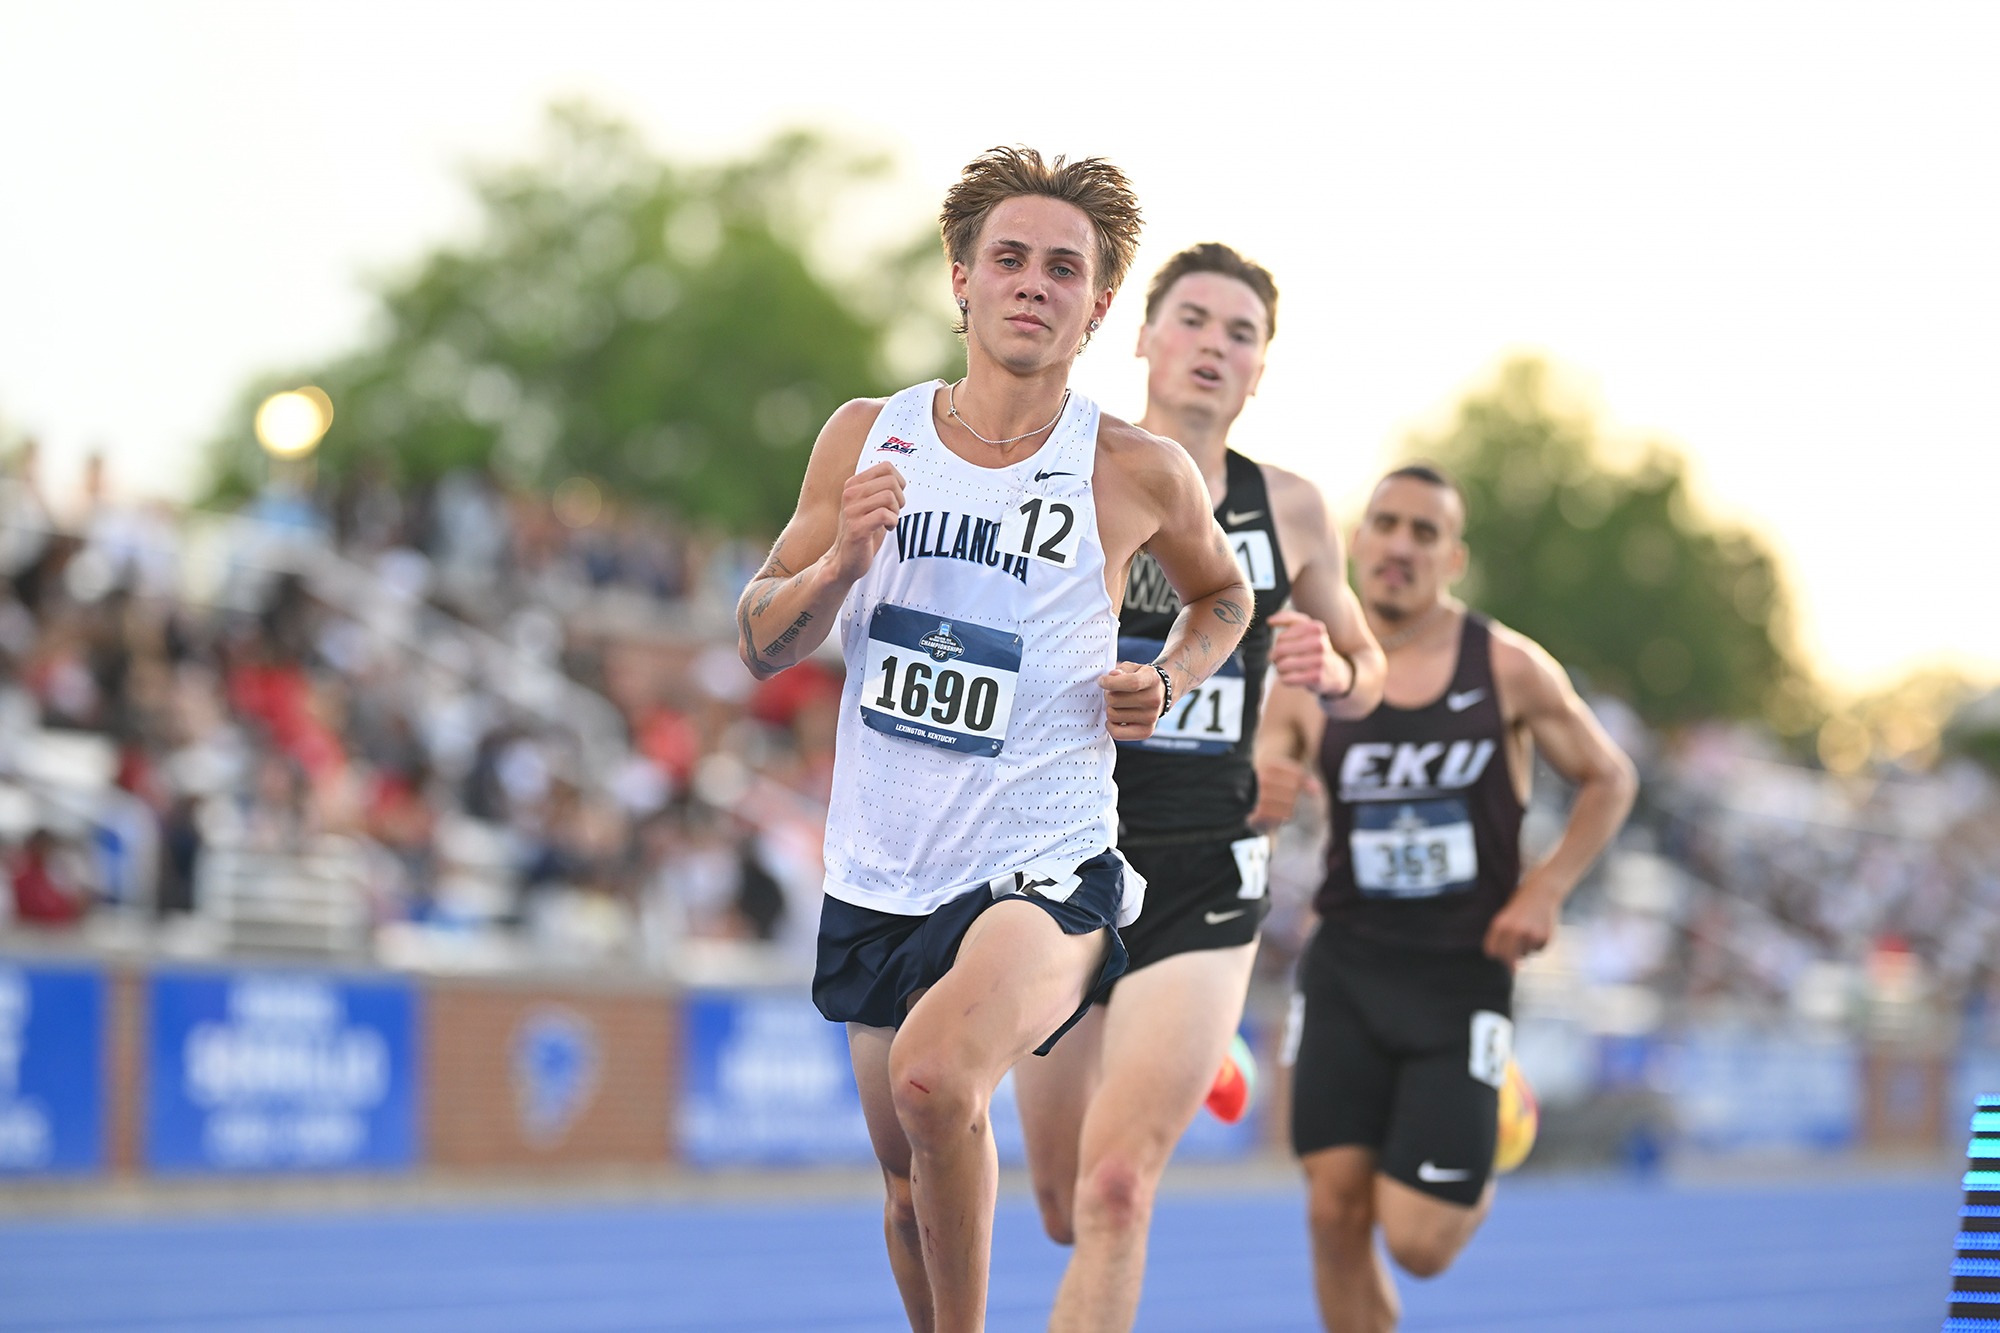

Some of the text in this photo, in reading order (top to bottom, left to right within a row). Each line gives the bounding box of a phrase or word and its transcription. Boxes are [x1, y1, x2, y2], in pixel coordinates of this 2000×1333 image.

[880, 441, 918, 454] EAST
[887, 436, 915, 448] BIG
[1019, 498, 1075, 564] 12
[920, 639, 963, 654] CHAMPIONSHIPS
[876, 655, 999, 732] 1690
[1177, 688, 1224, 733] 71
[895, 723, 958, 744] LEXINGTON, KENTUCKY
[1337, 739, 1497, 792] EKU
